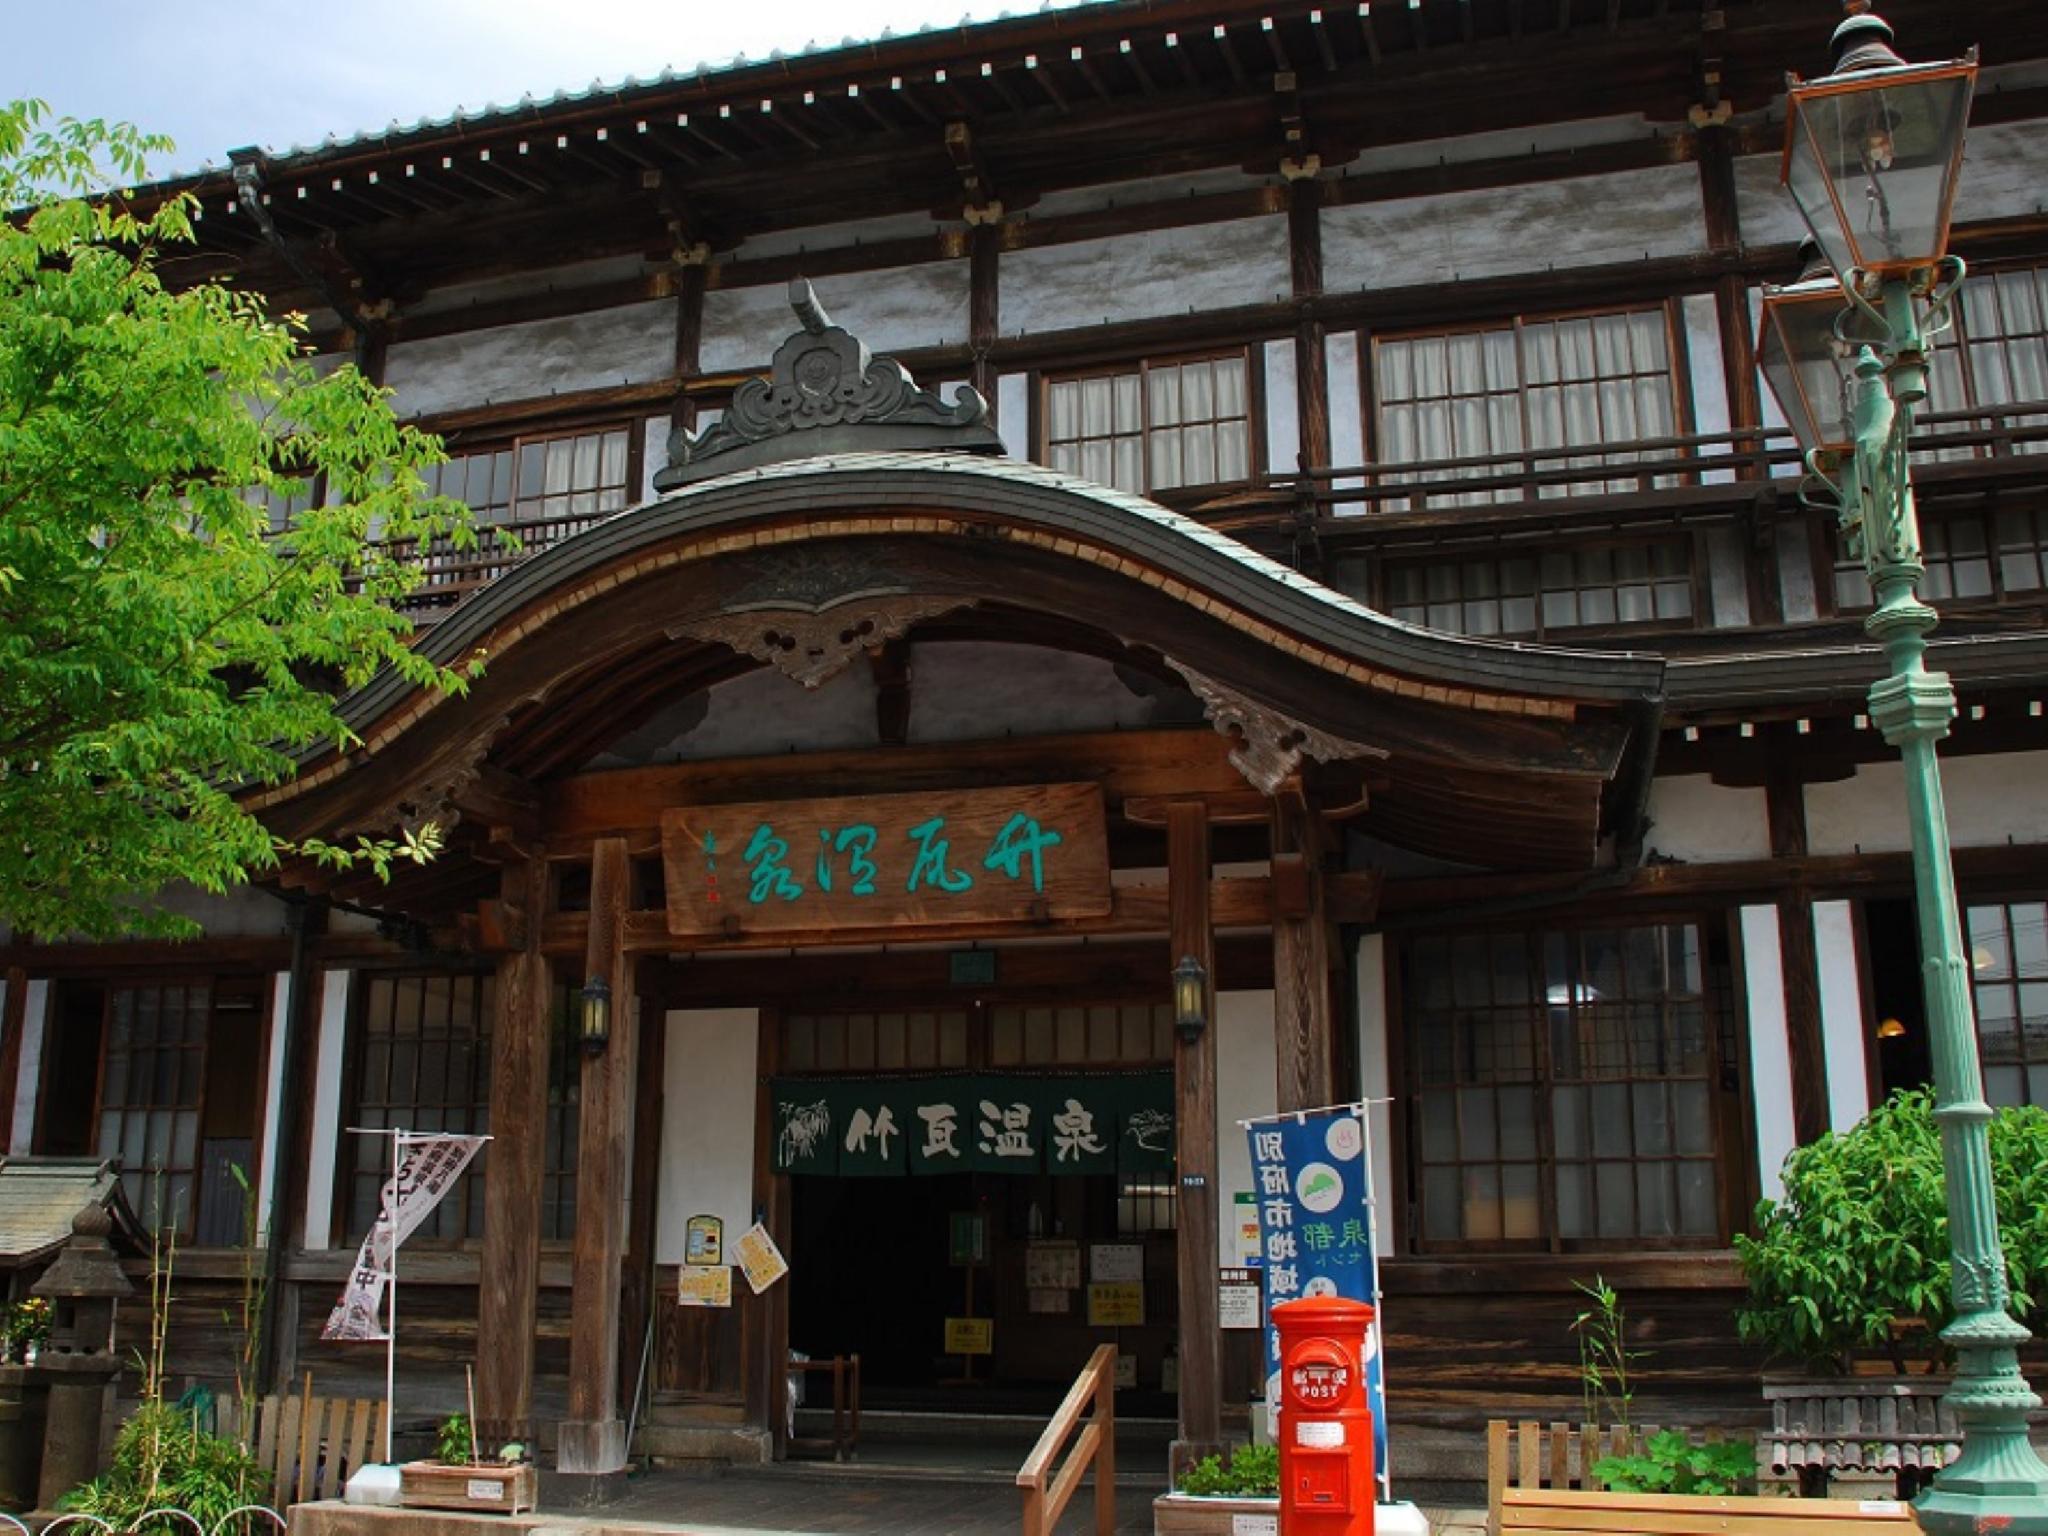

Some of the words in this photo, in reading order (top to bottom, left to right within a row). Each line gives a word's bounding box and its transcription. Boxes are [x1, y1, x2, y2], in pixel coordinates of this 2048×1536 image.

[846, 1099, 1107, 1162] 竹瓦温泉
[1300, 1385, 1338, 1398] POST
